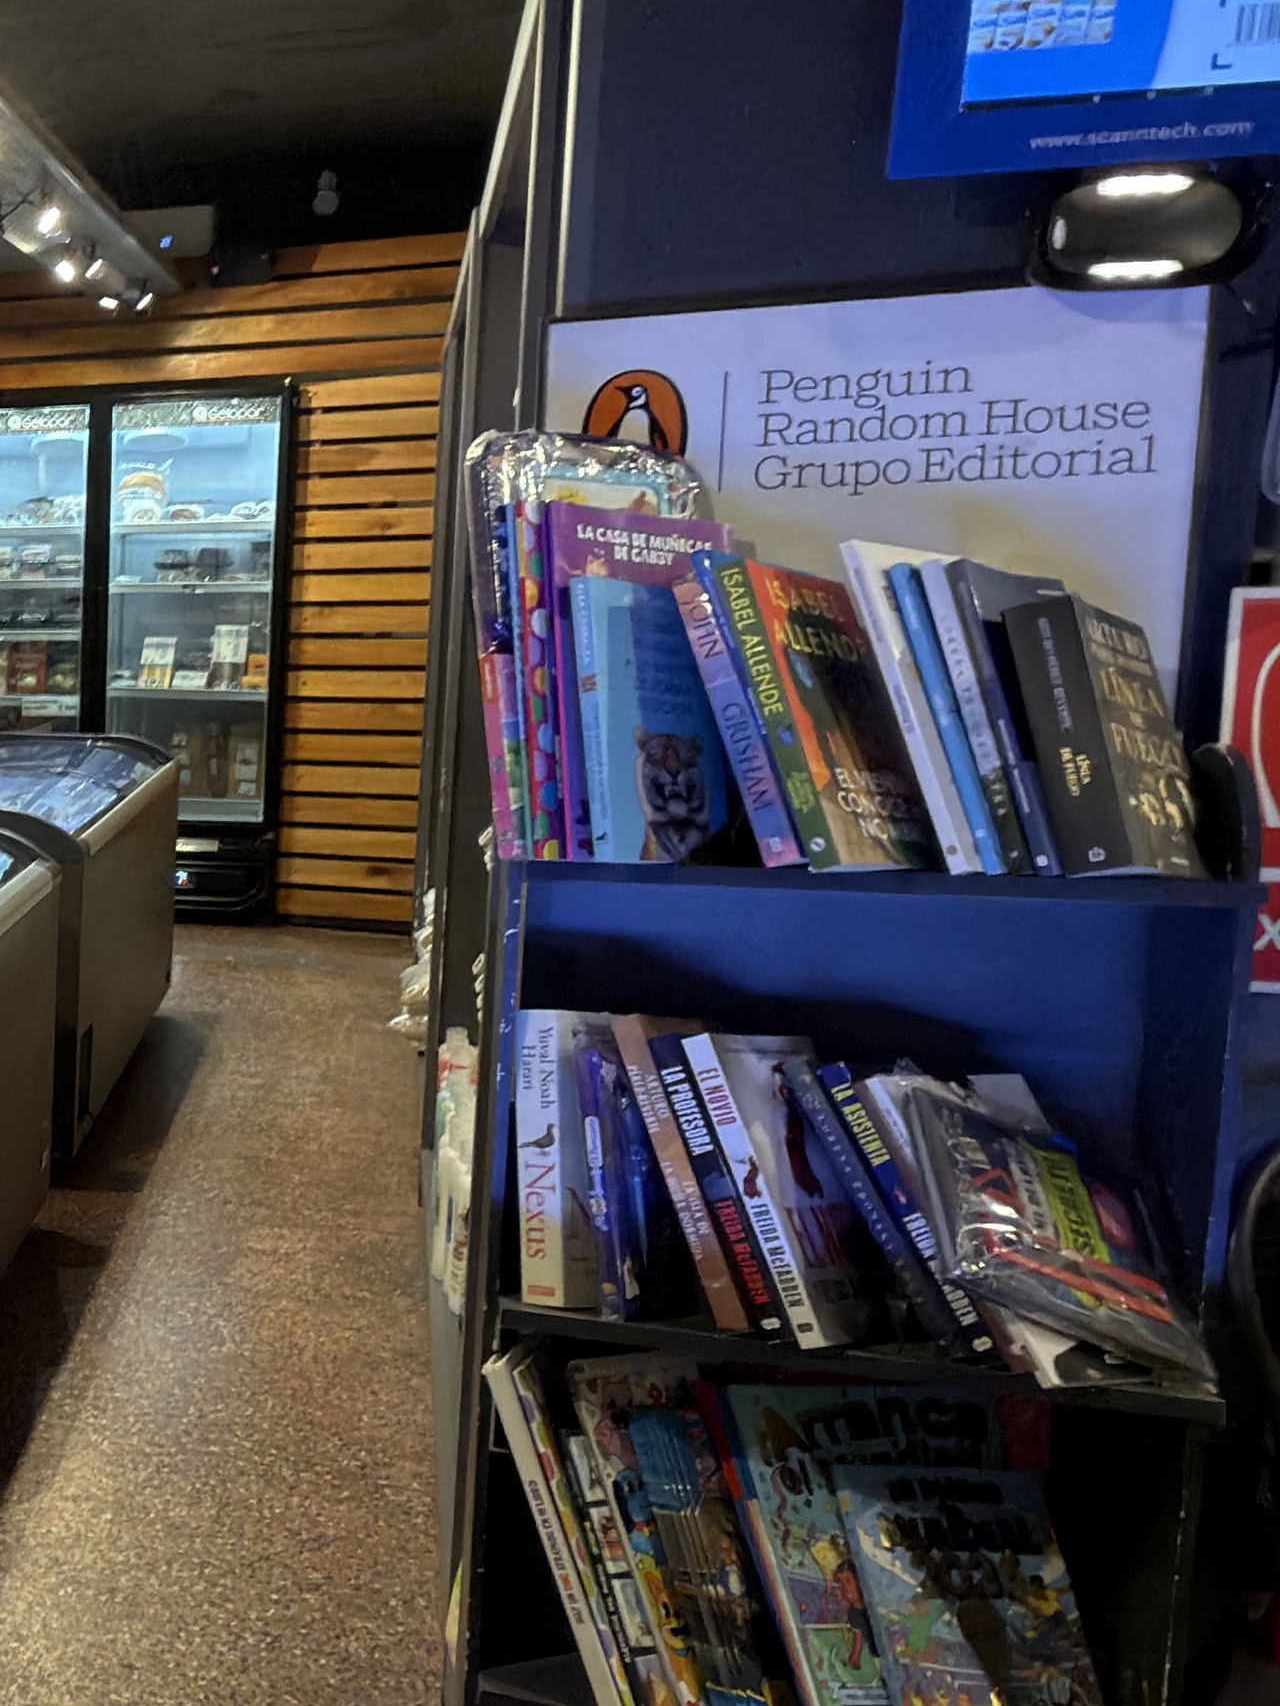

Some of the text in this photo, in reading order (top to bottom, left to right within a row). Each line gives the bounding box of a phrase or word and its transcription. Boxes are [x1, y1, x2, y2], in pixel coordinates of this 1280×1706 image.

[1029, 121, 1255, 149] www.scanntech.com
[761, 361, 972, 414] Penguin
[757, 398, 1153, 447] Random House
[754, 437, 1157, 495] Grupo Editorial
[577, 524, 594, 541] LA
[596, 527, 629, 545] CASA
[721, 567, 784, 716] ISABEL ALLENDE
[683, 593, 772, 812] JOHN GRISHAM
[522, 1045, 537, 1090] Harari
[539, 1026, 558, 1110] Yuval Noah
[643, 1074, 669, 1118] ARTURO
[831, 1082, 854, 1102] LA
[661, 1065, 715, 1157] LA PROFESORA
[842, 1102, 890, 1167] ASISTENTA
[524, 1161, 556, 1260] Nexus
[697, 1067, 806, 1308] EL NOVIO FREIDA McFADDEN
